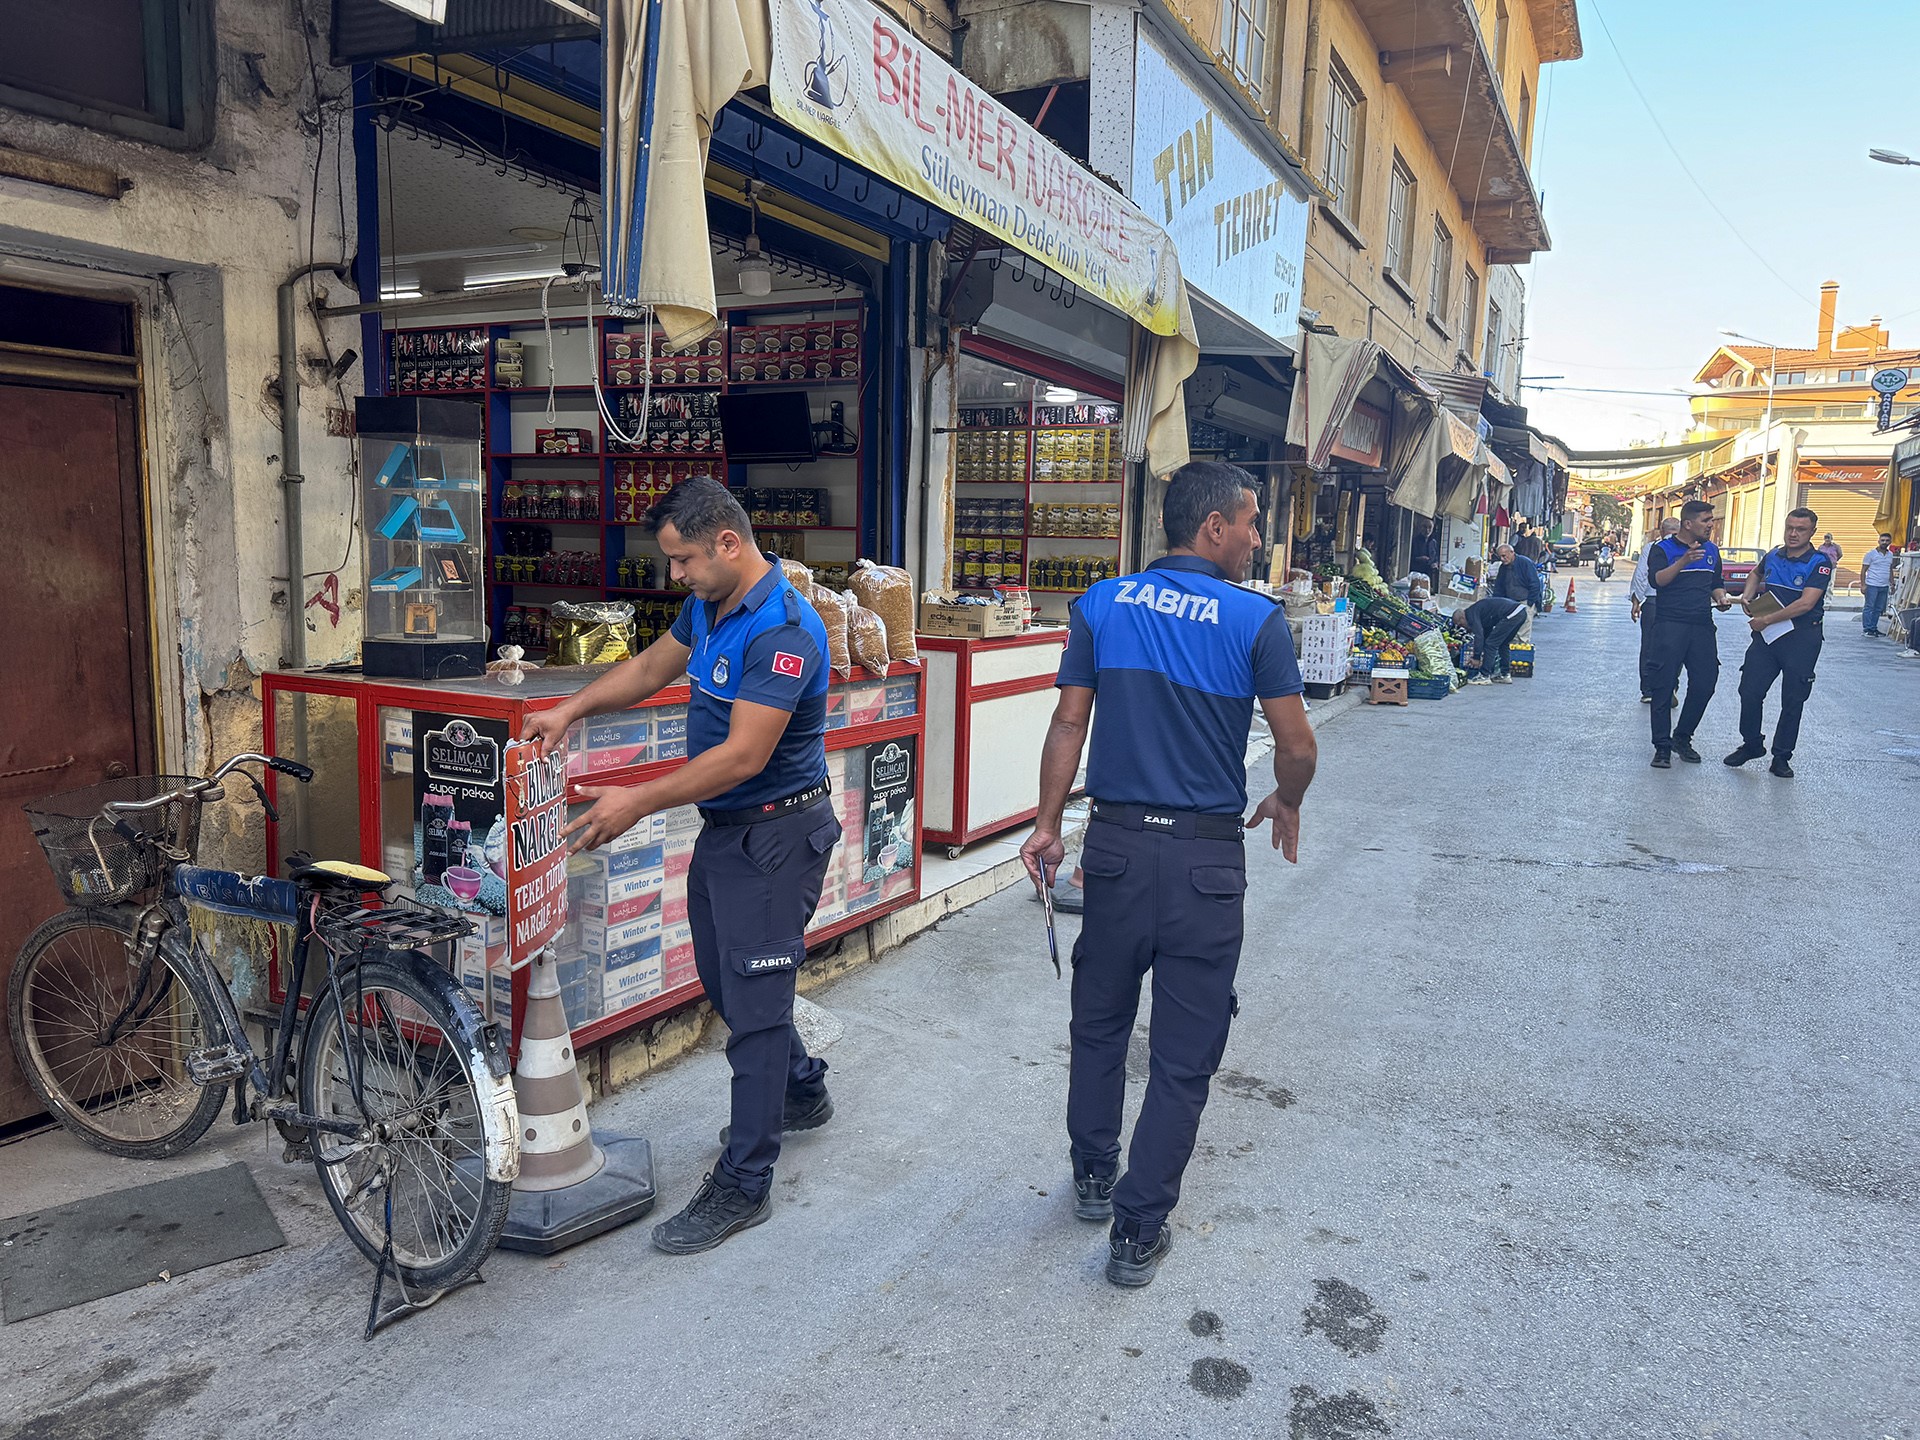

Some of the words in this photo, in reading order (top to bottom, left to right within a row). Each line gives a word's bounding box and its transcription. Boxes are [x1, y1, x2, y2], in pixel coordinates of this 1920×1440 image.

[1153, 109, 1214, 226] TAN
[921, 144, 1008, 232] Süleyman
[1012, 204, 1079, 274] Dede'nin
[1084, 254, 1108, 289] Yeri
[1114, 581, 1219, 624] ZABITA
[662, 725, 685, 735] WAMUS
[593, 733, 621, 743] WAMUS
[432, 747, 490, 768] SELİMÇAY
[662, 747, 684, 757] WAMUS
[593, 756, 621, 767] WAMUS
[429, 783, 459, 796] super
[462, 786, 495, 800] pekoe
[1143, 815, 1176, 826] ZABI
[664, 839, 687, 851] Wintor
[613, 858, 639, 870] WAMUS
[624, 879, 650, 892] Wintor
[514, 875, 545, 912] TEKEL
[613, 905, 637, 918] WAMUS
[516, 901, 552, 947] NARGİLE
[622, 924, 647, 939] Wintor
[751, 956, 792, 968] ZABITA
[618, 970, 648, 988] Wintor
[621, 990, 647, 1007] Wintor
